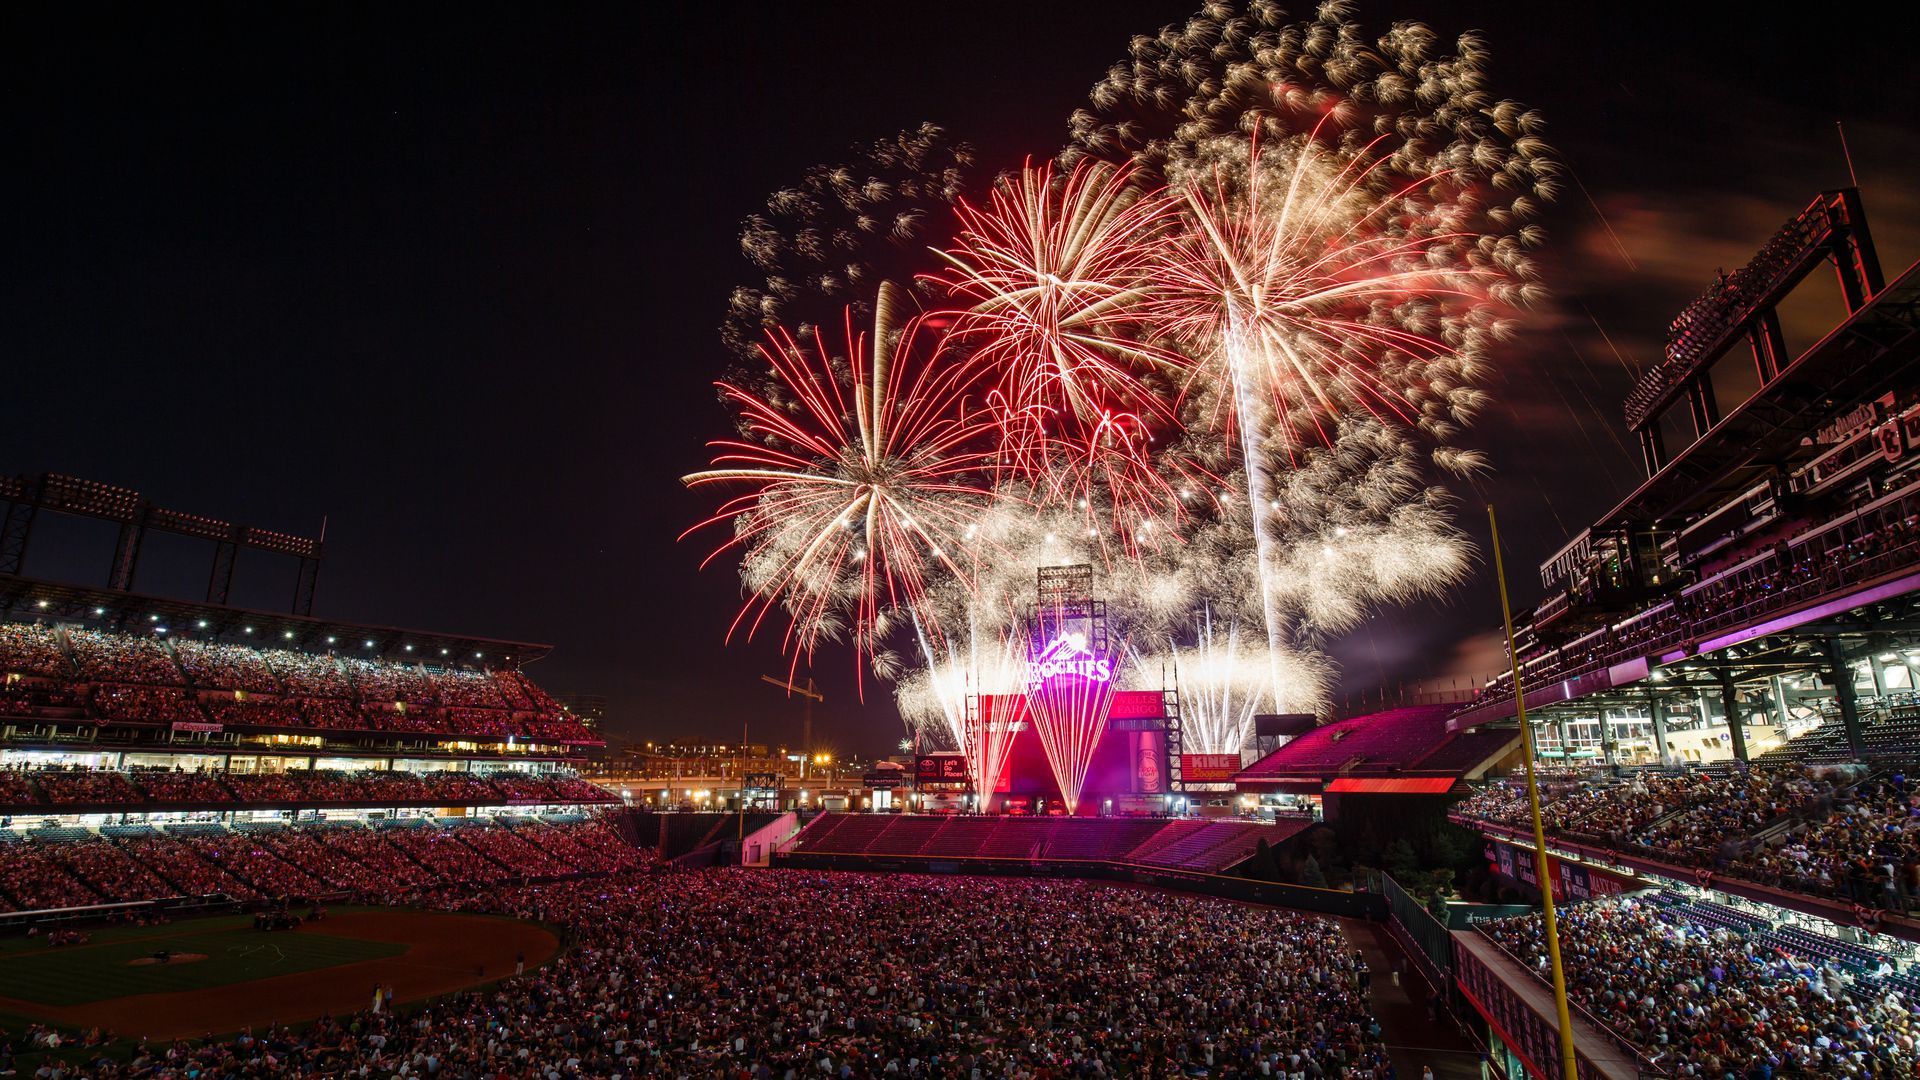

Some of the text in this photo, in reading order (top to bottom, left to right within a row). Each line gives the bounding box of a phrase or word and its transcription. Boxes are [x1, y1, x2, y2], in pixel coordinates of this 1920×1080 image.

[1541, 564, 1556, 589] THE
[1027, 659, 1110, 683] ROCKIES
[1116, 695, 1157, 704] WELLS
[1117, 704, 1157, 714] FARGO
[1192, 756, 1230, 768] KING
